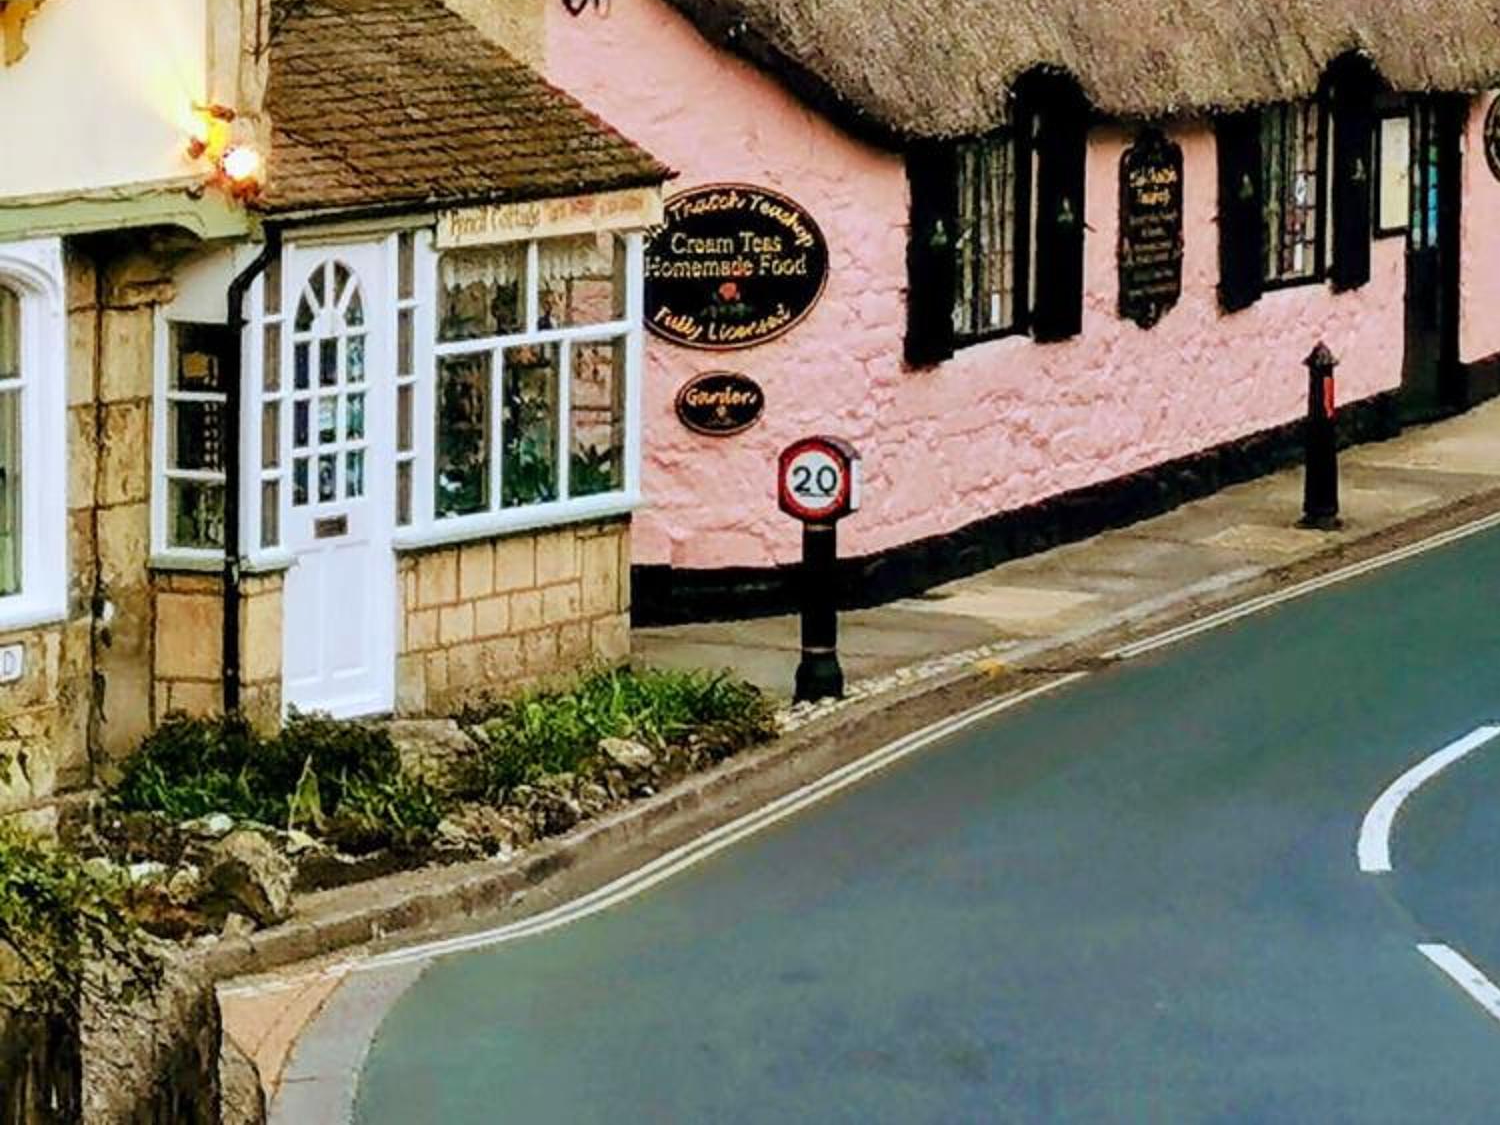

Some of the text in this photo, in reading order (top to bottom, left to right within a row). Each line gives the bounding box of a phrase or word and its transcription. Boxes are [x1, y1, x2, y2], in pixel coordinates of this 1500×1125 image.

[671, 230, 783, 254] Cream Teas
[644, 253, 807, 278] Homemade Food
[653, 305, 703, 341] Fully
[792, 464, 838, 494] 20
